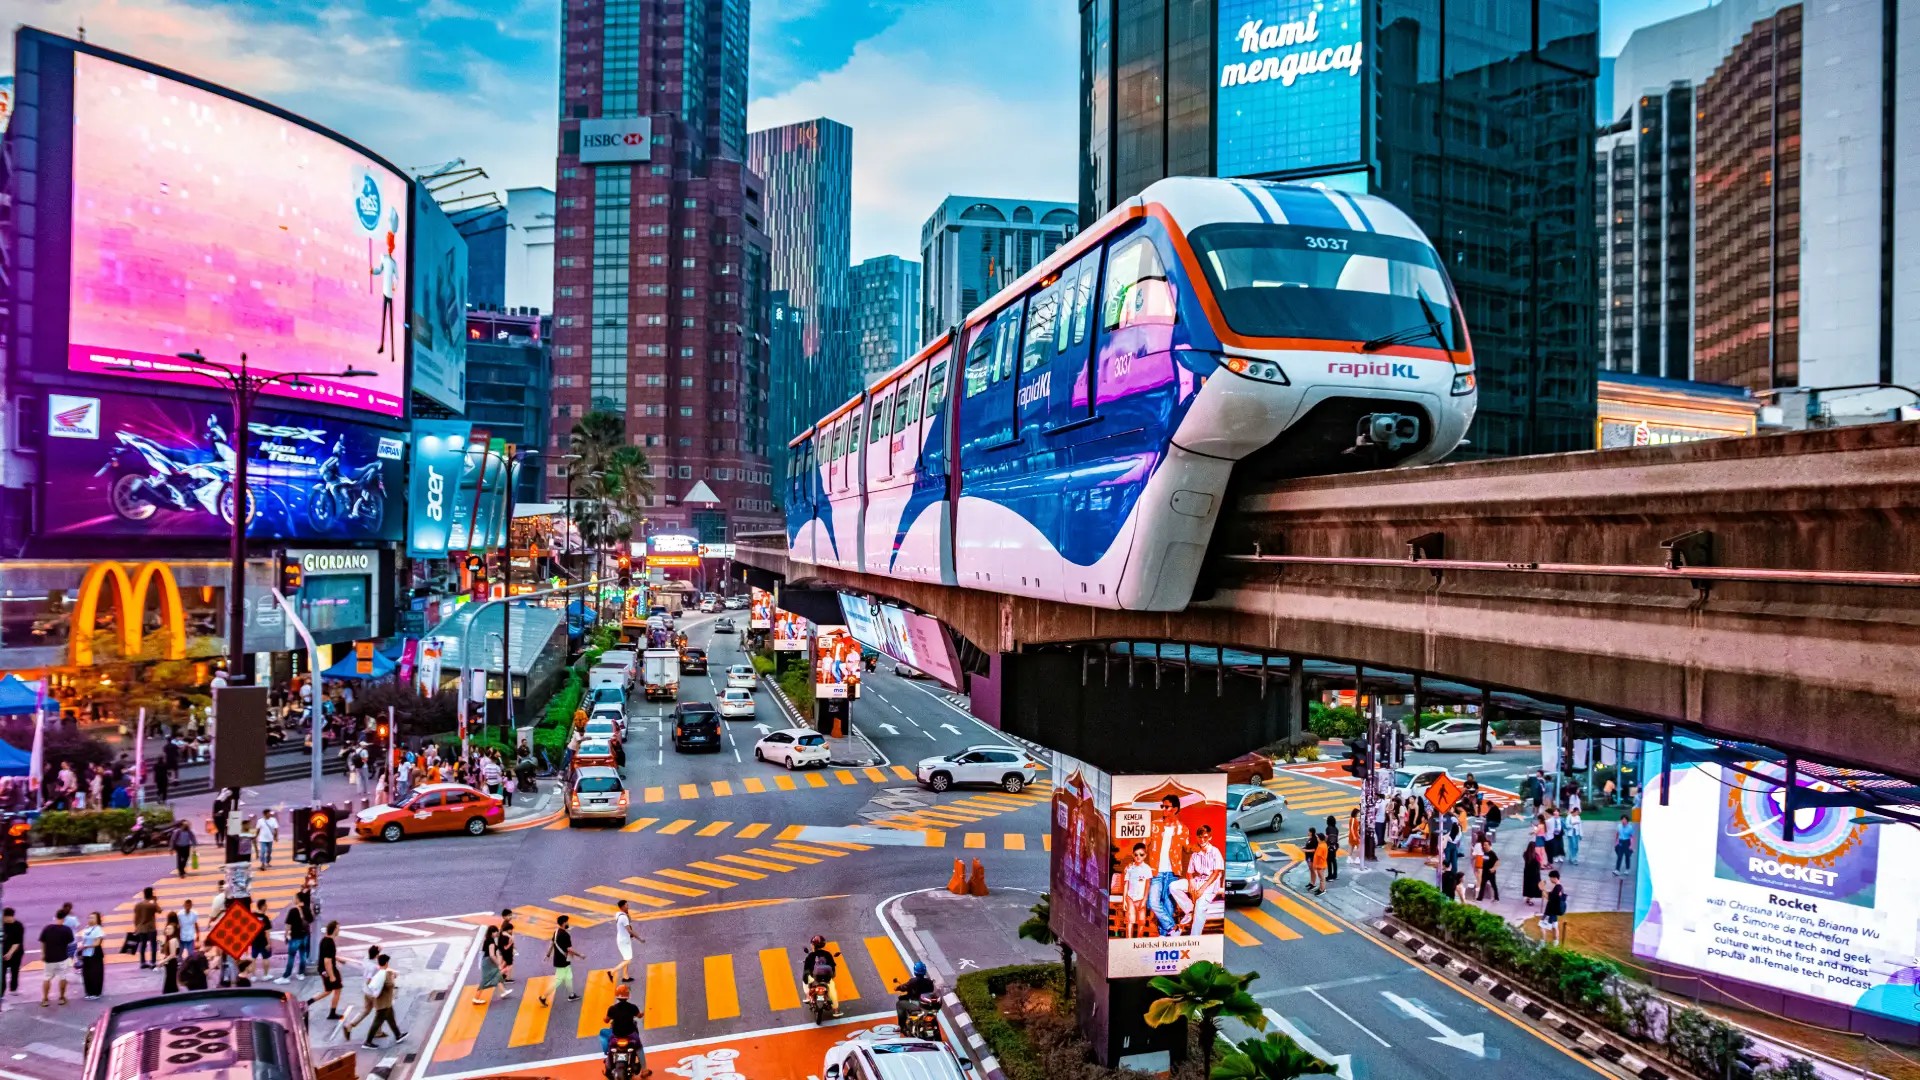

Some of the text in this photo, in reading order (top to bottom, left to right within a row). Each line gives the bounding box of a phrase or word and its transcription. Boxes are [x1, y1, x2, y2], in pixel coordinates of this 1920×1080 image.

[1238, 11, 1320, 54] Kami
[583, 134, 622, 147] HSBC
[1304, 236, 1349, 250] 3037
[1113, 351, 1133, 378] 3037
[1327, 361, 1420, 380] rapidKL
[427, 464, 444, 522] acer
[303, 553, 369, 572] GIORDANO
[1123, 813, 1143, 821] KEMEJA
[1120, 825, 1146, 837] RM59
[1748, 856, 1839, 888] ROCKET
[1768, 893, 1818, 914] Rocket
[1706, 897, 1880, 940] with Christina Warren, Brianna Wu
[1731, 913, 1850, 946] & Simone de Rochefort
[1154, 949, 1191, 961] max
[1162, 940, 1200, 949] Ramadan
[1713, 922, 1872, 965] Geek out about tech and geek
[1707, 947, 1746, 961] popular
[1748, 955, 1799, 974] all-female
[1801, 967, 1825, 980] tech
[1714, 936, 1869, 977] culture with the first and most
